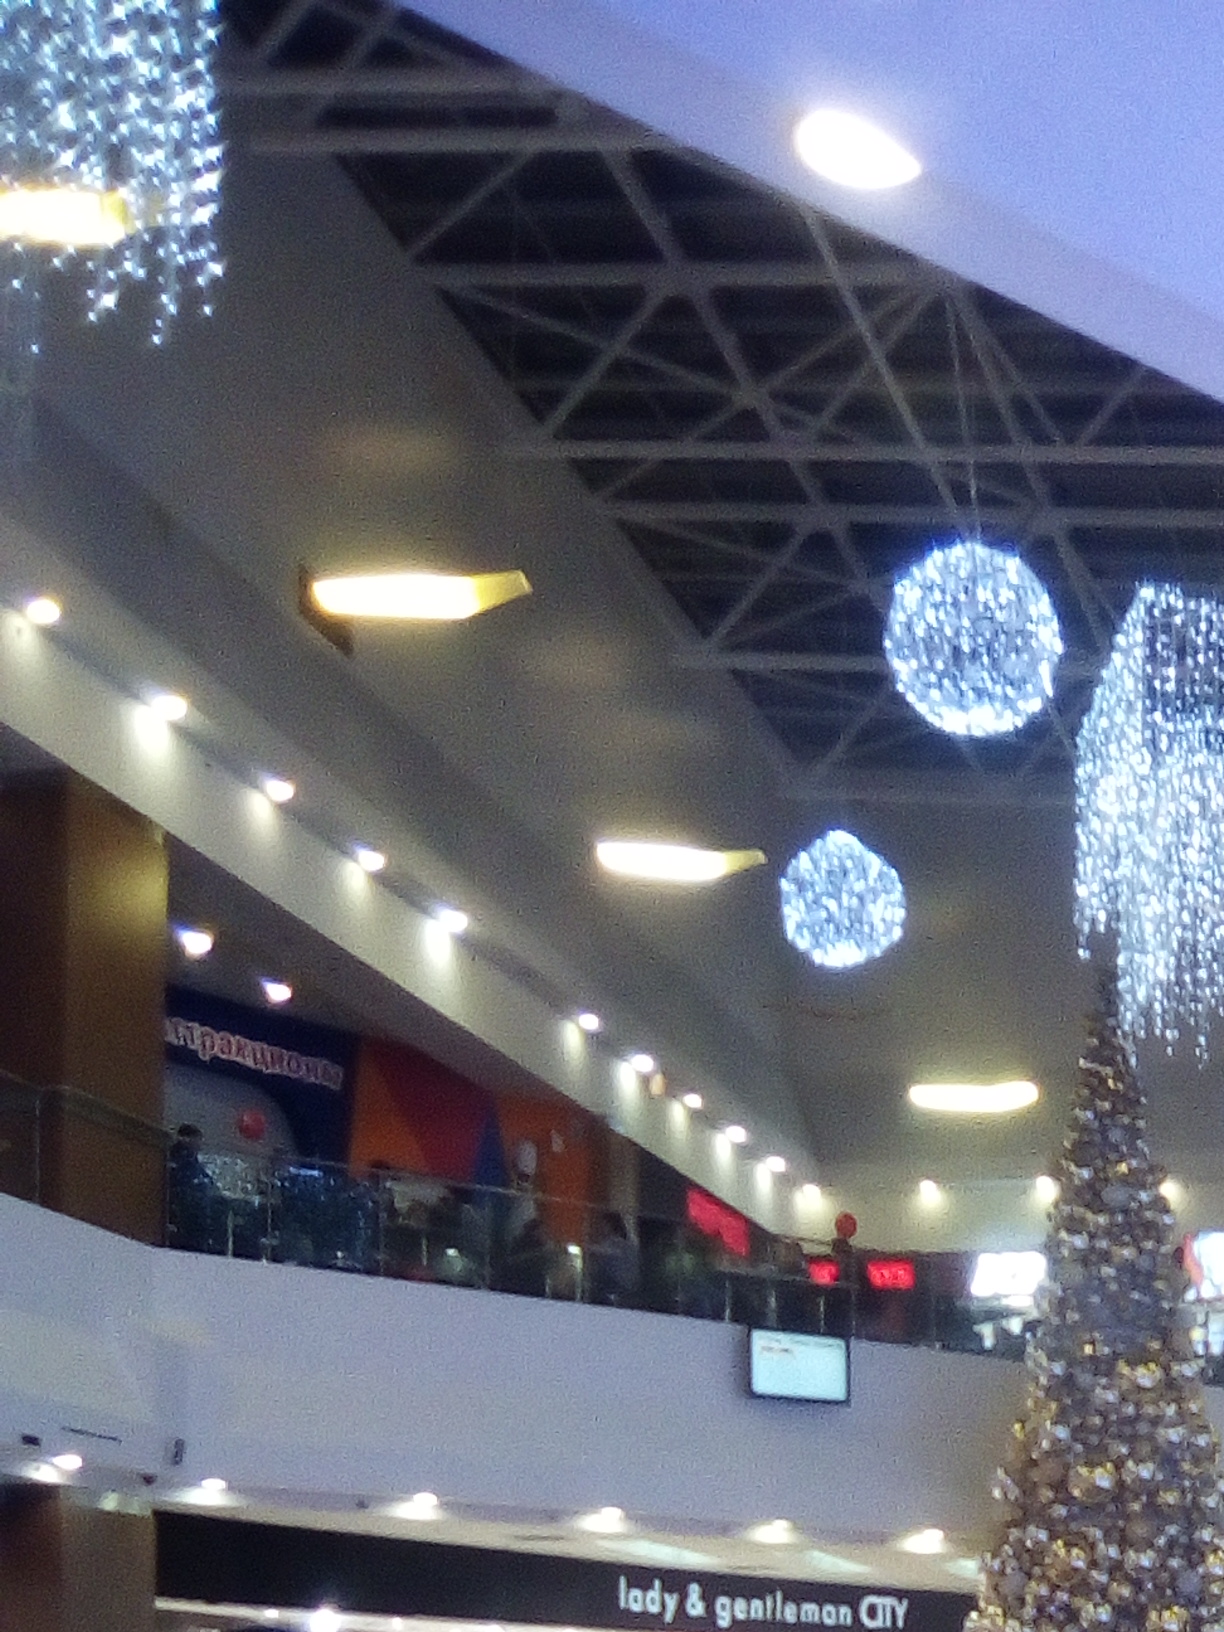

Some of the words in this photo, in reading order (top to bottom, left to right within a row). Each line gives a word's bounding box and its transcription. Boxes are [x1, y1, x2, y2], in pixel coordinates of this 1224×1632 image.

[618, 1575, 680, 1625] lady
[685, 1582, 706, 1618] &
[714, 1588, 852, 1629] gentleman
[859, 1594, 908, 1630] CITY
